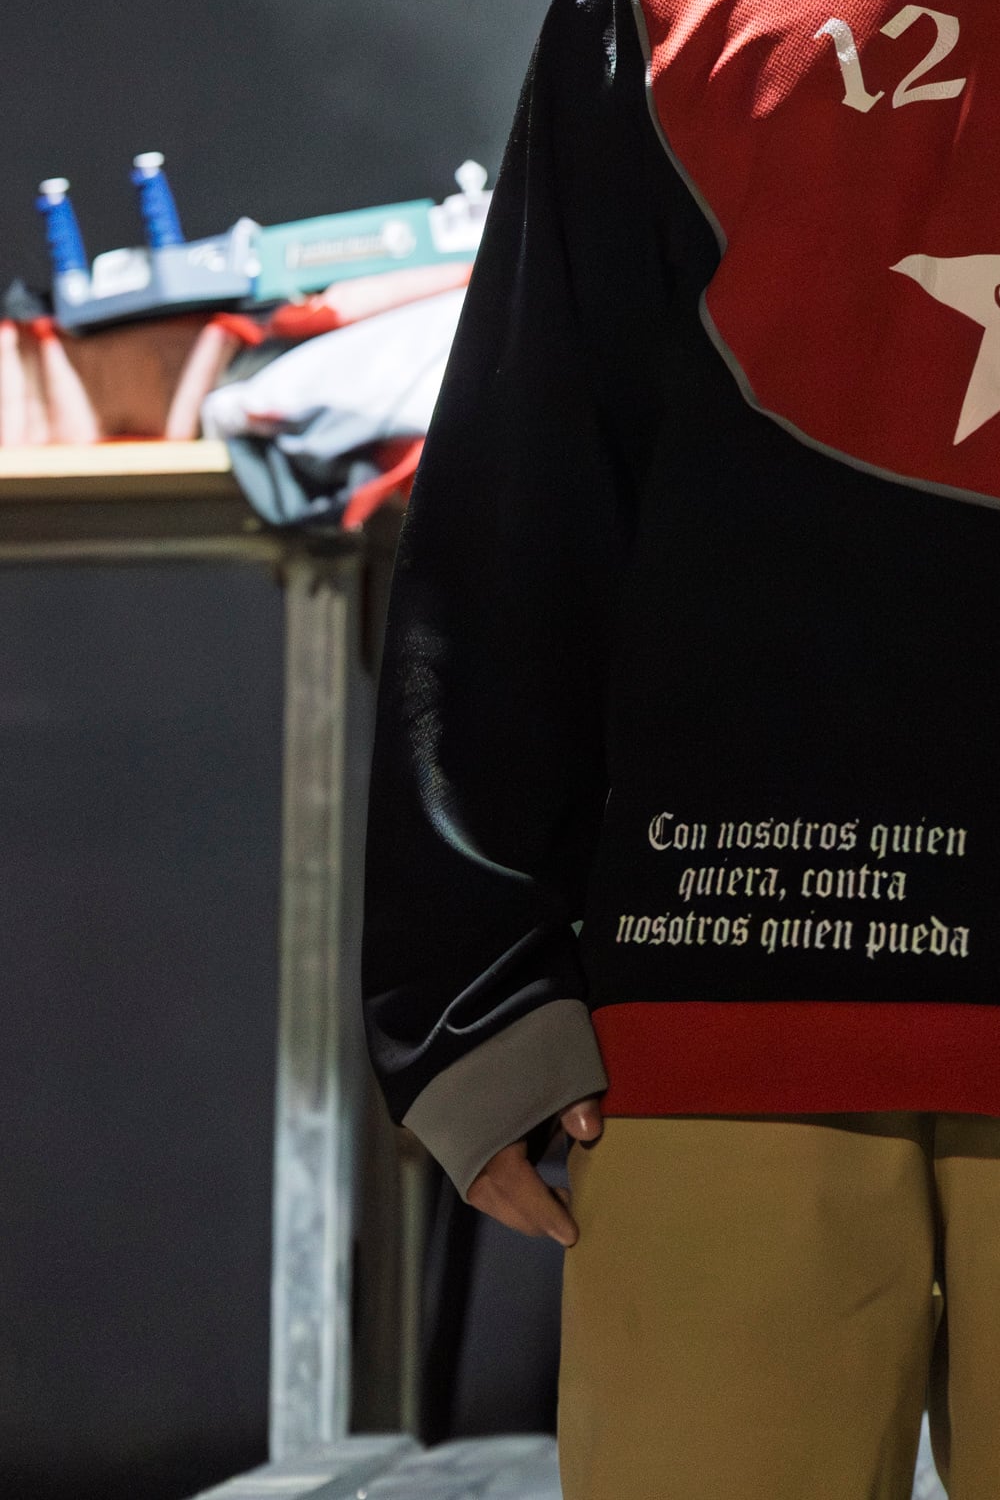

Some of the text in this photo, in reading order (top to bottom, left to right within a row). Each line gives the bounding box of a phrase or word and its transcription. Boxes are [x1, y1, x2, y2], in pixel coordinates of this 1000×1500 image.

[813, 4, 967, 113] 12
[648, 811, 968, 859] Con nosotros quien
[678, 857, 907, 902] quiera, contra
[615, 910, 970, 960] nosotros quien pueda
